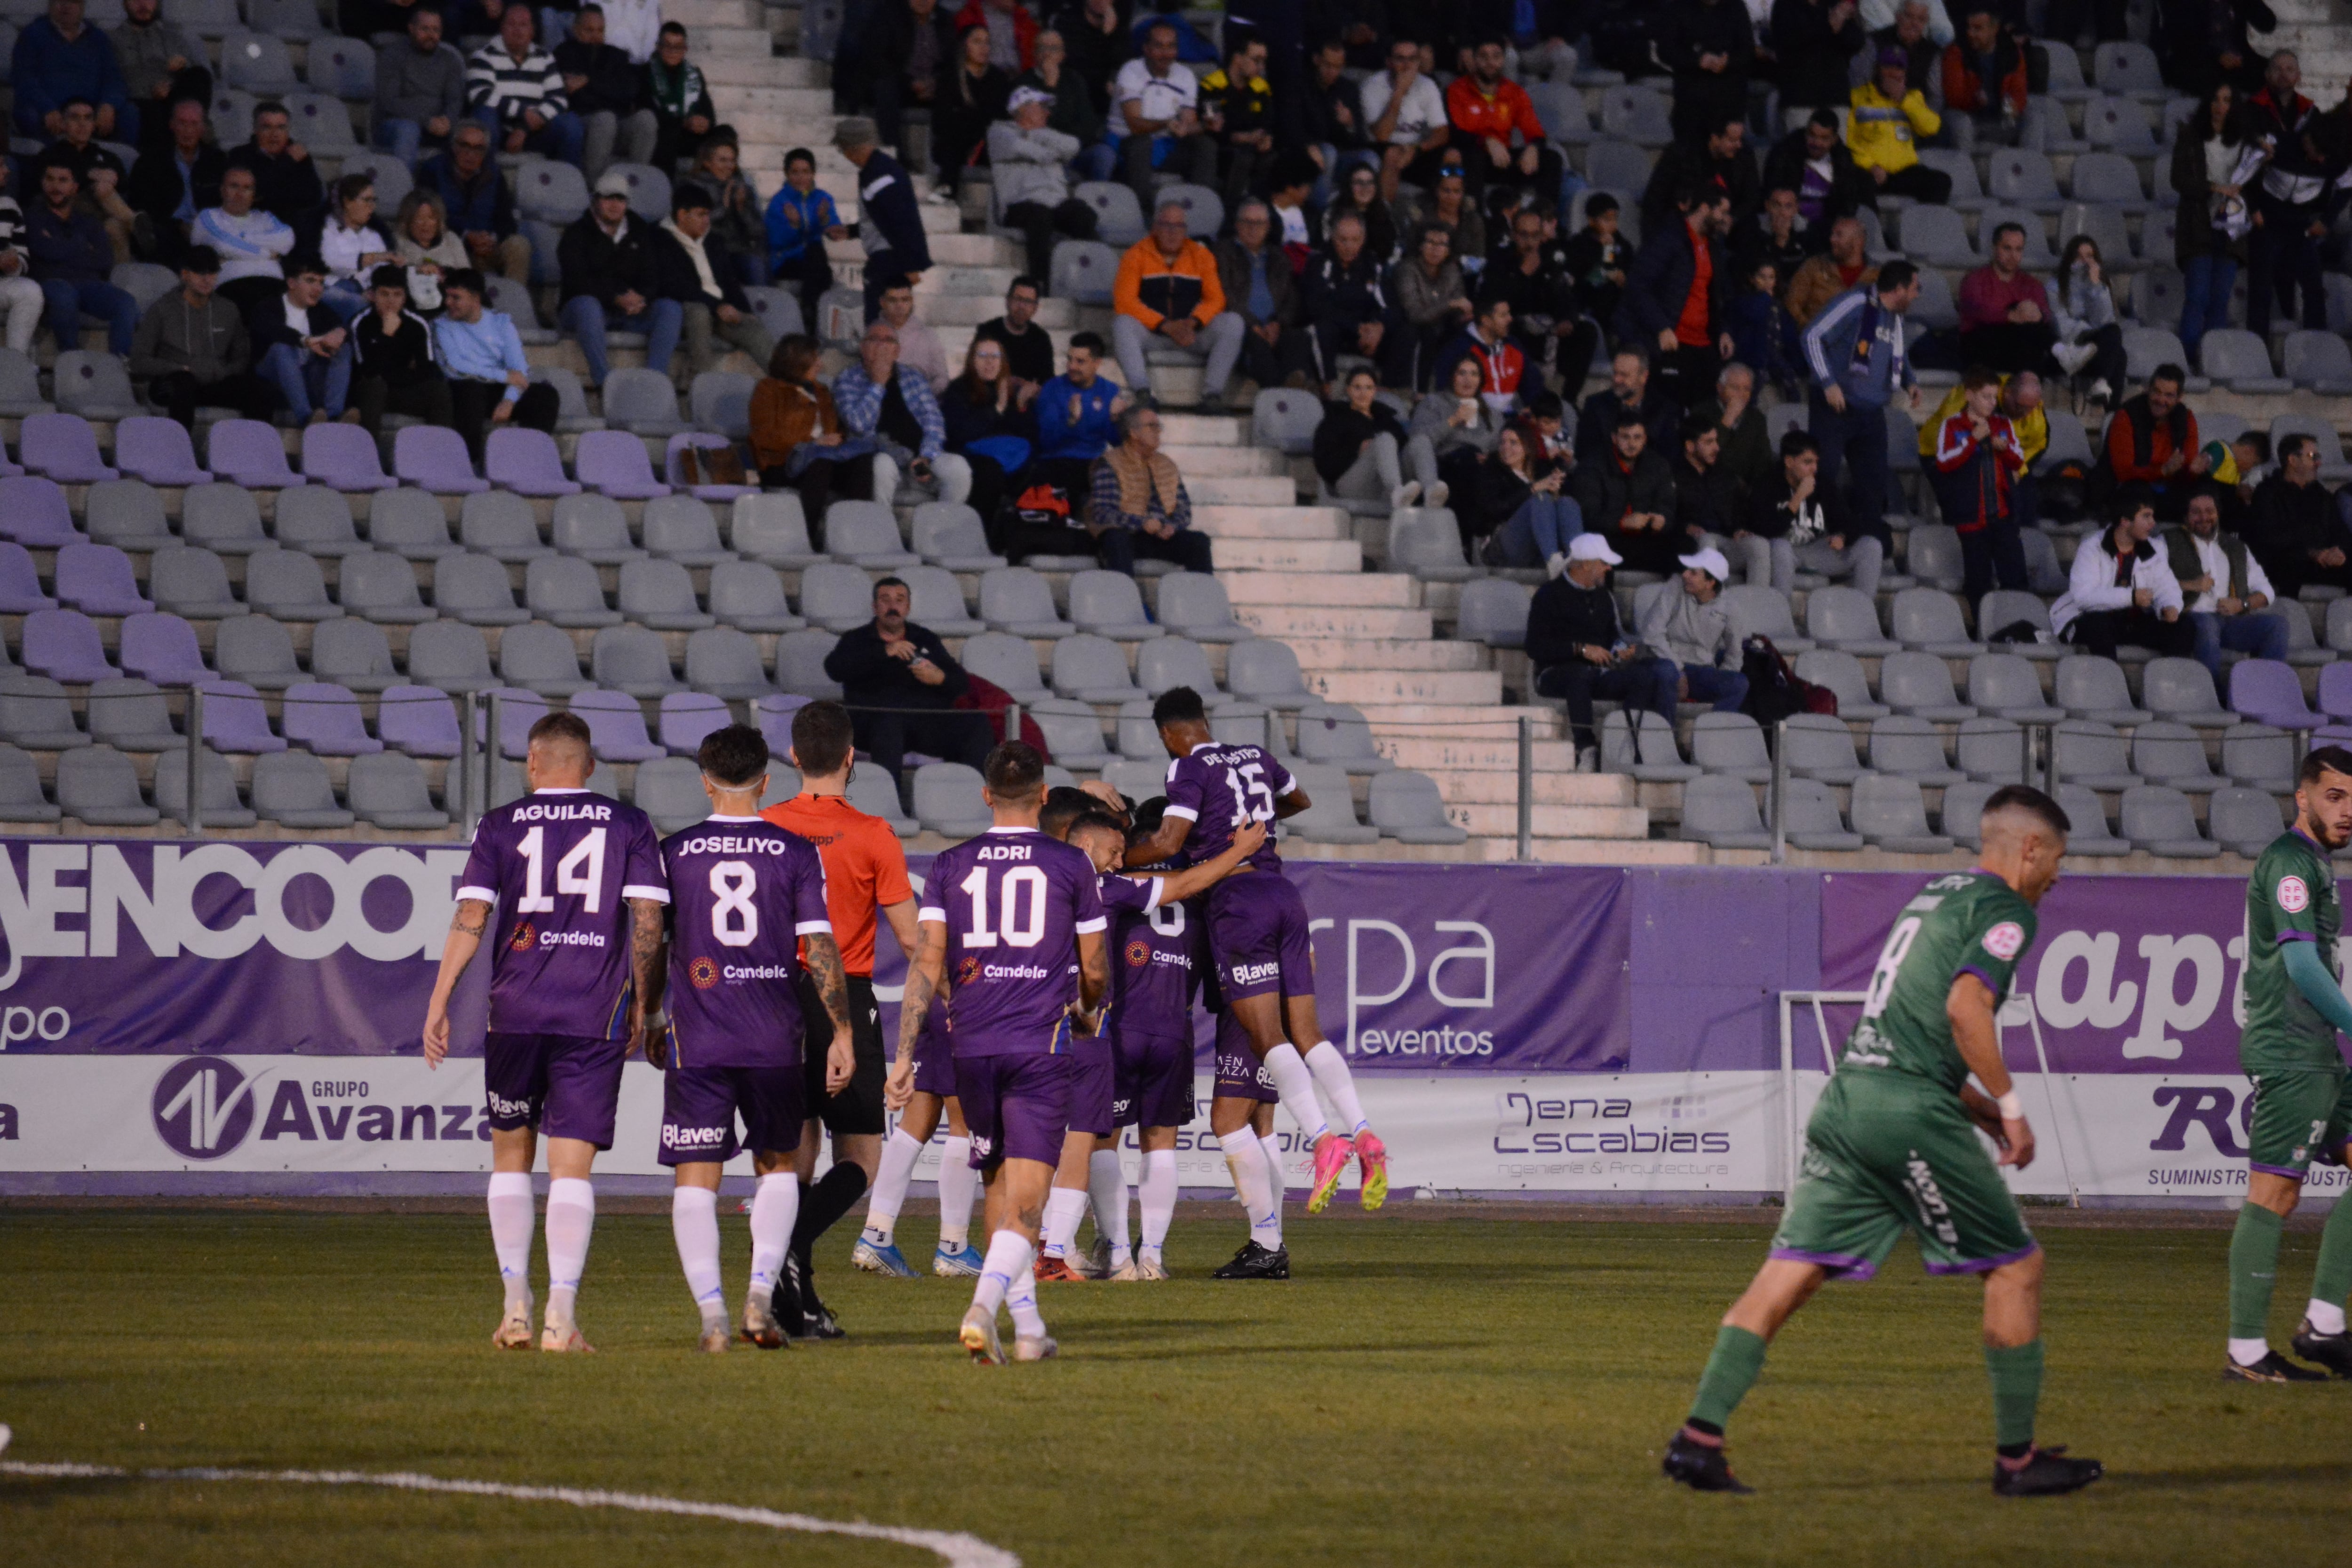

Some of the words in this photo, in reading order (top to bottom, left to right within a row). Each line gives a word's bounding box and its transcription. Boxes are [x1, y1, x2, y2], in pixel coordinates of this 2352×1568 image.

[1202, 753, 1223, 766] DE
[1225, 762, 1275, 827] 15
[512, 804, 612, 823] AGUILAR
[679, 836, 786, 856] JOSELIYO
[977, 845, 1032, 860] ADRI
[516, 826, 607, 913] 14
[709, 860, 758, 947] 8
[960, 866, 1047, 948] 10
[540, 930, 605, 947] Candela
[984, 964, 1048, 979] Candela
[1232, 962, 1279, 985] Blaveo
[1360, 1025, 1493, 1056] eventos
[312, 1081, 369, 1097] GRUPO
[662, 1123, 724, 1149] Blaveo
[1494, 1123, 1730, 1154] Escabias
[1590, 1162, 1602, 1174] &
[1610, 1162, 1728, 1176] Arquitectura
